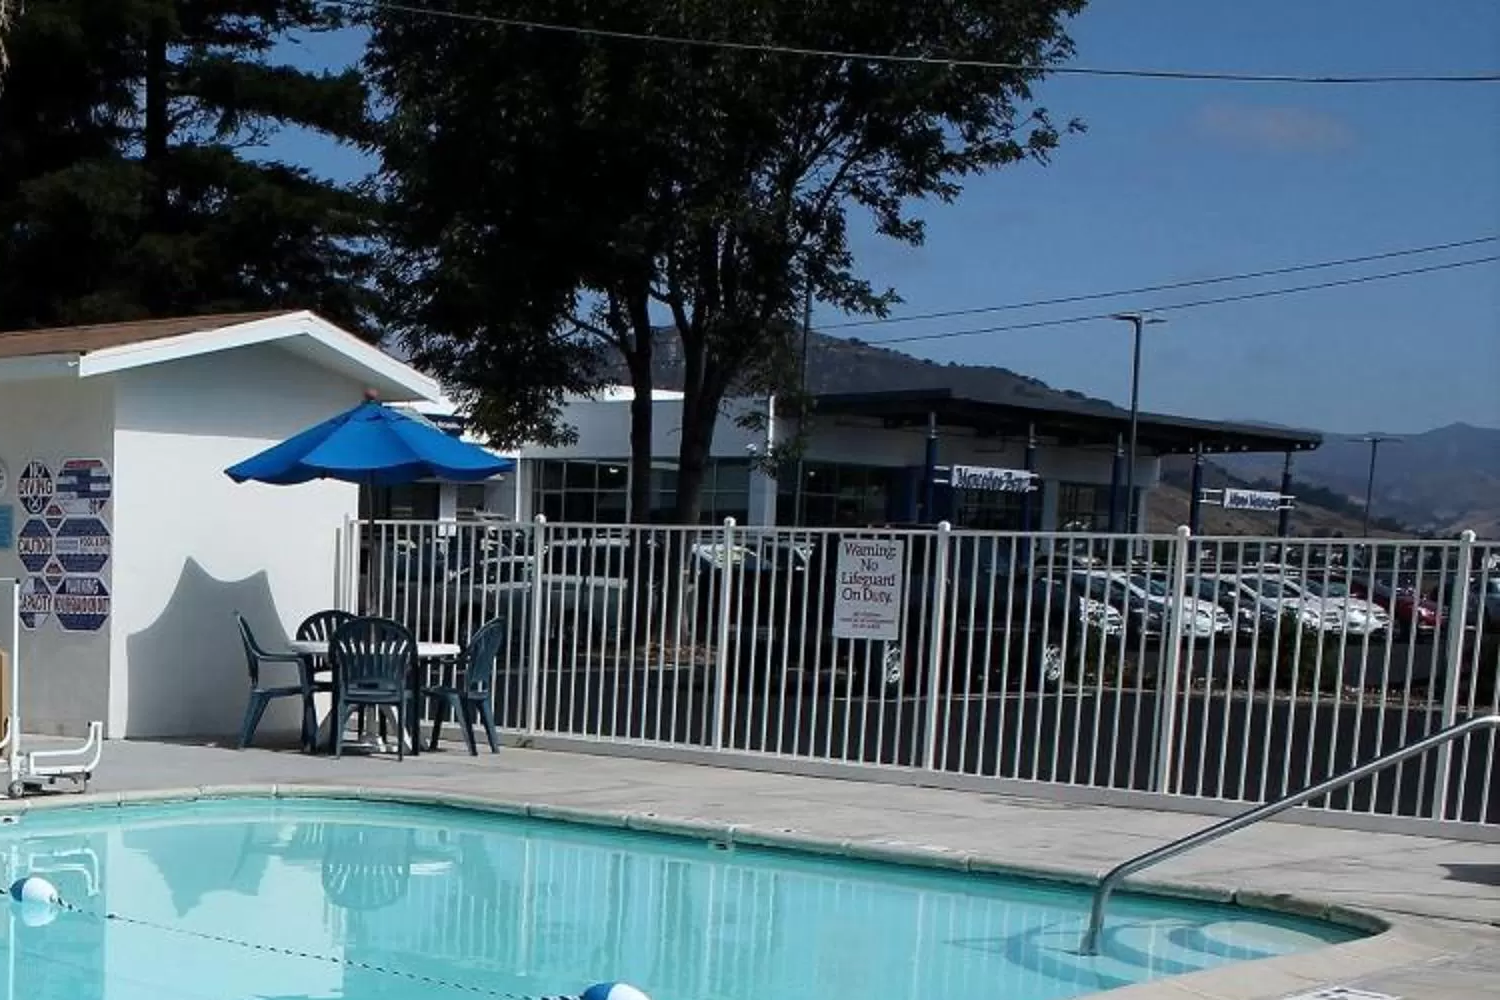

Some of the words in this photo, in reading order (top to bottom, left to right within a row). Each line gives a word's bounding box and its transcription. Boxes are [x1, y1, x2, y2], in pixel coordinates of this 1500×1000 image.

[18, 479, 52, 495] DIVING
[861, 559, 879, 571] No
[841, 571, 896, 588] Lifeguard
[842, 587, 861, 601] On
